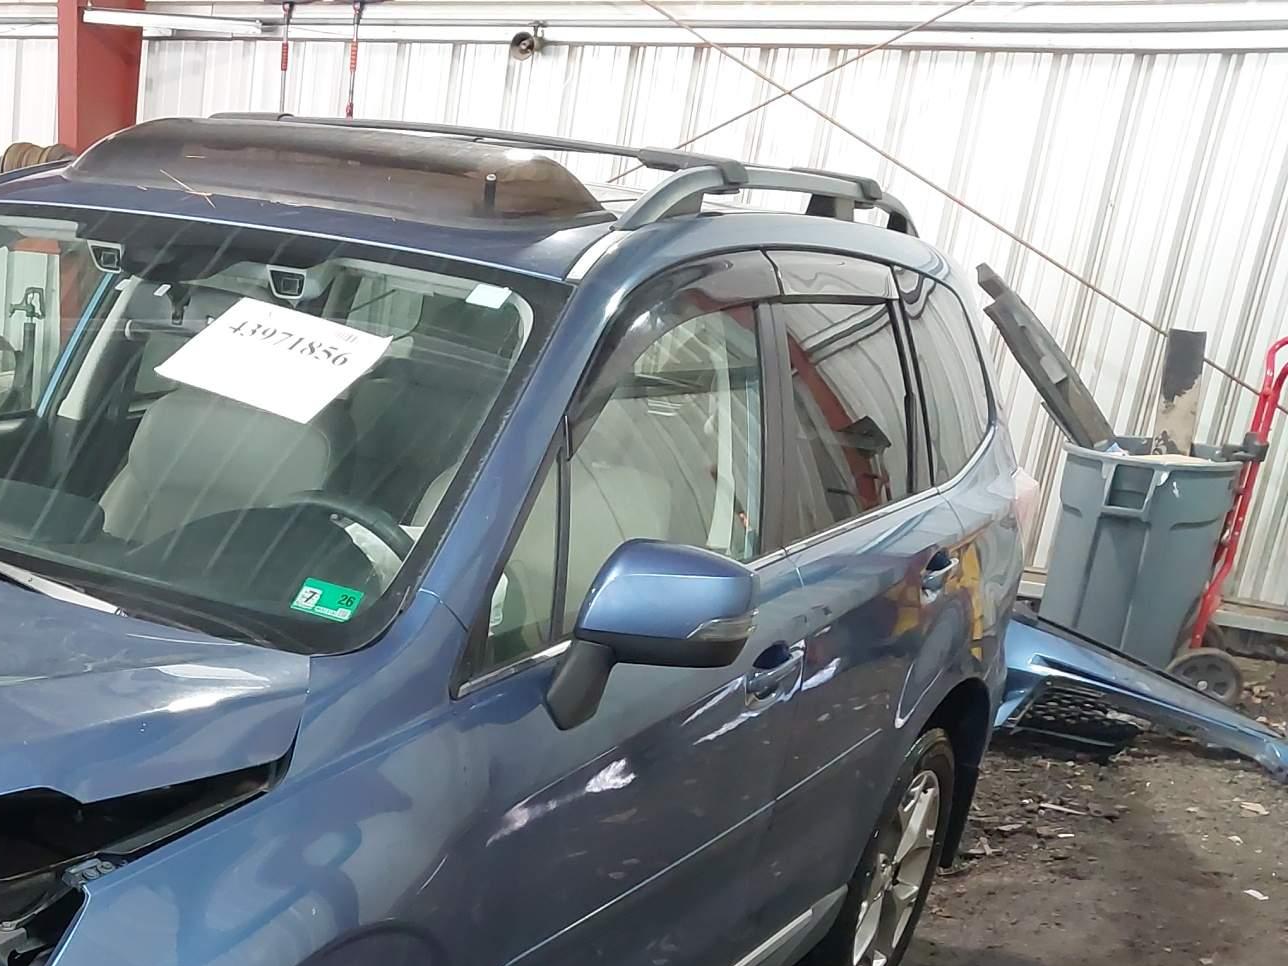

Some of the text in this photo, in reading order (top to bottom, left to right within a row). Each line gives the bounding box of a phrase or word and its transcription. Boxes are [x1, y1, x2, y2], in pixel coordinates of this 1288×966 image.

[227, 319, 350, 367] 43971856
[303, 590, 357, 607] 7 26
